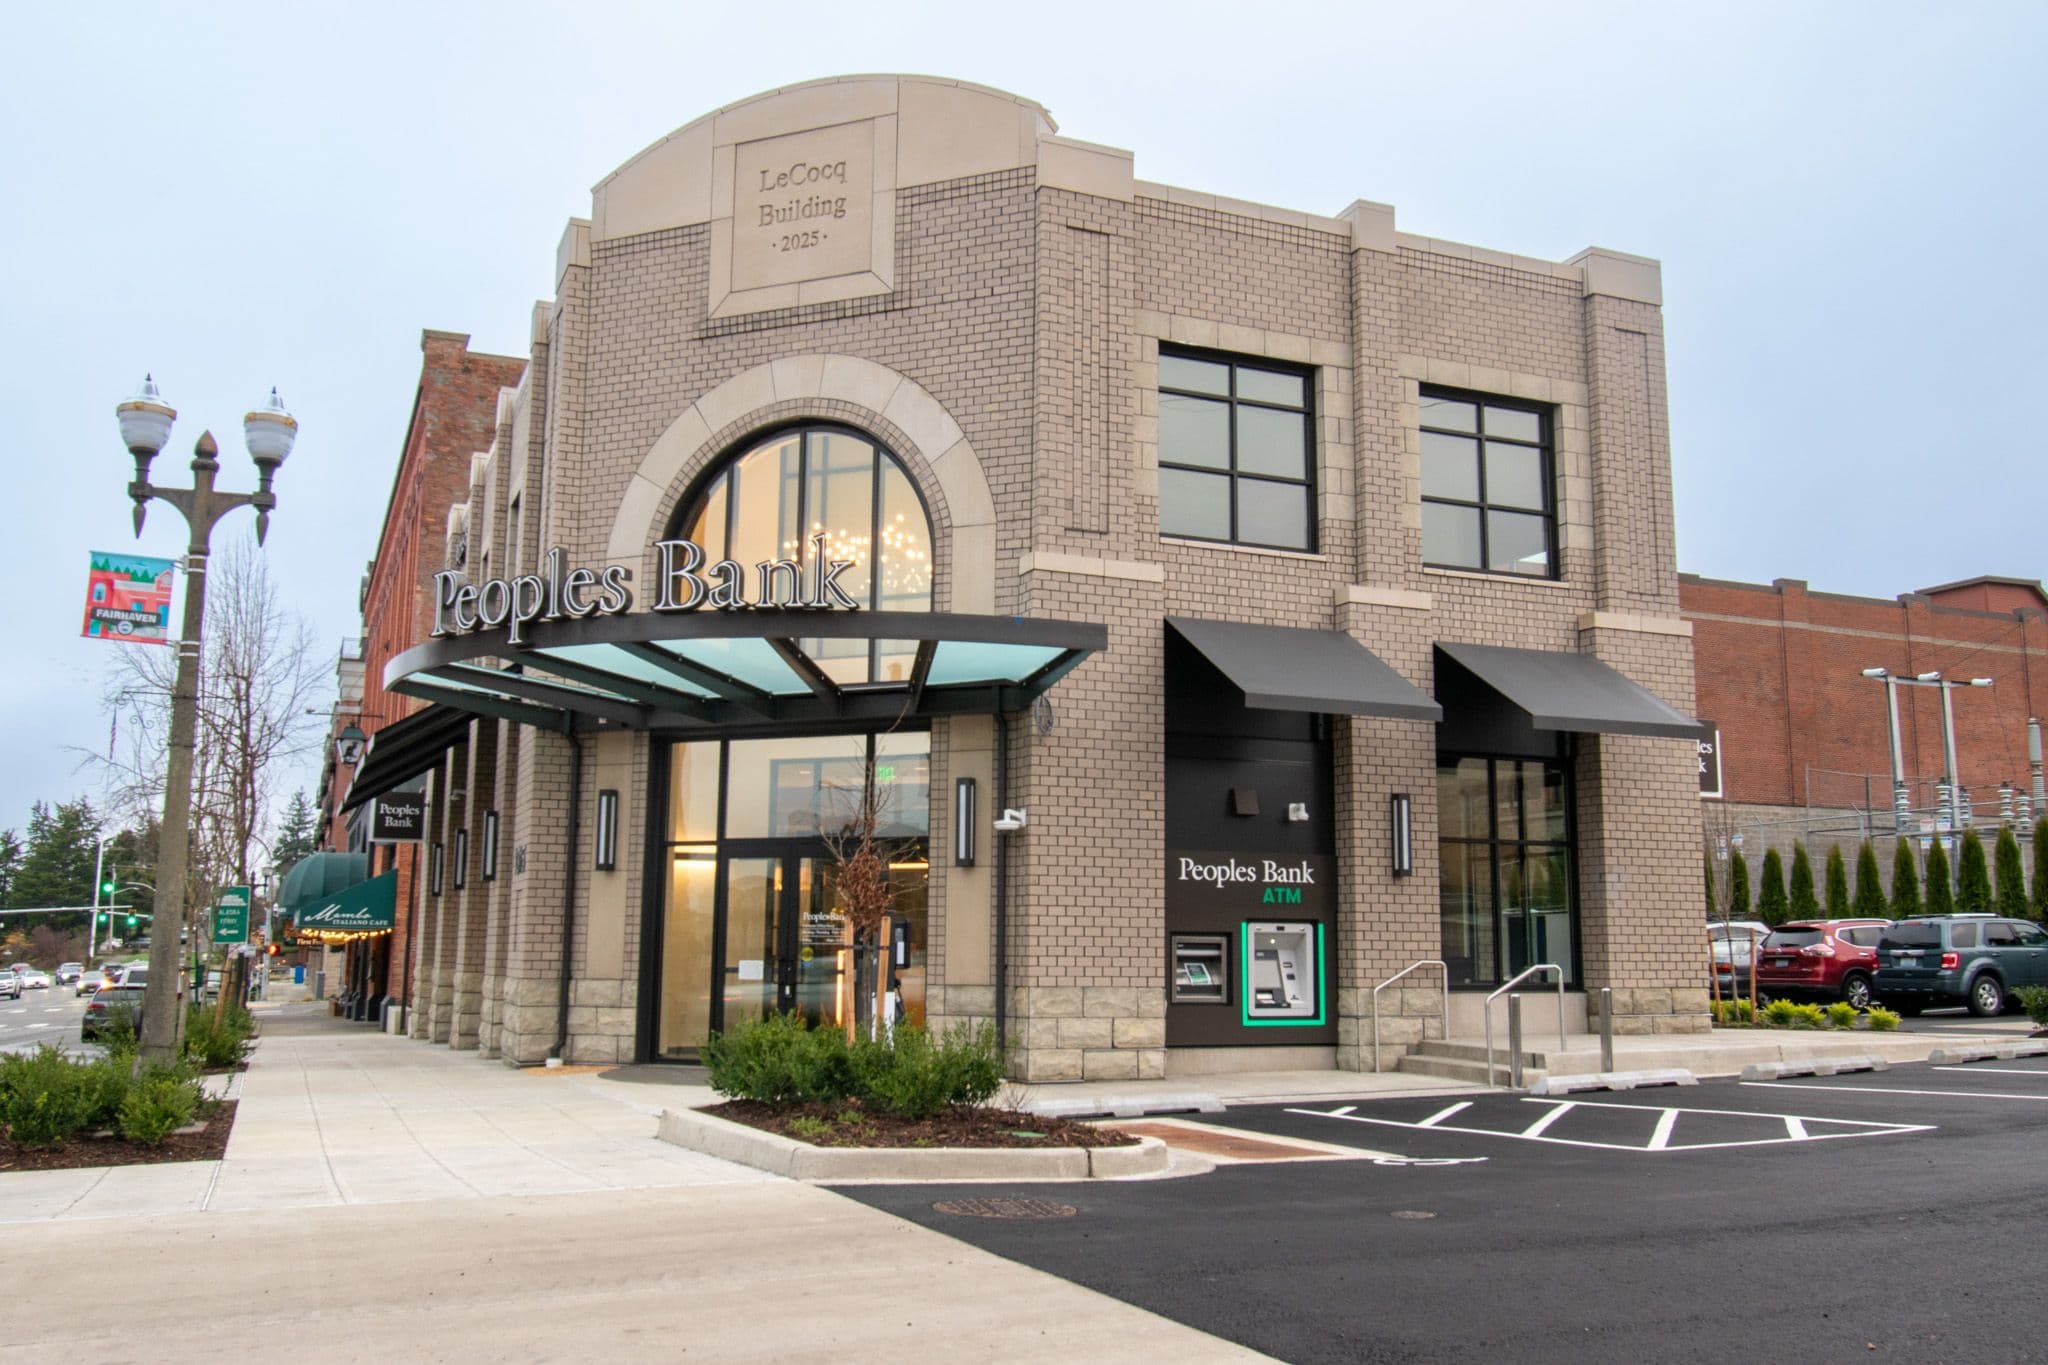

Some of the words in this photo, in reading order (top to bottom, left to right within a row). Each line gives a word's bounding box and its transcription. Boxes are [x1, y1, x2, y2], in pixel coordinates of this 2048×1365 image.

[759, 160, 848, 193] LeCocq
[758, 195, 847, 228] Building
[429, 546, 633, 646] Peoples
[652, 532, 860, 613] Bank
[96, 608, 157, 623] FAIRHAVEN
[379, 803, 420, 818] Peoples
[384, 816, 414, 828] Bank
[1178, 857, 1257, 888] Peoples
[1262, 860, 1315, 884] Bank
[1263, 887, 1302, 905] ATM
[304, 903, 372, 921] Mambo
